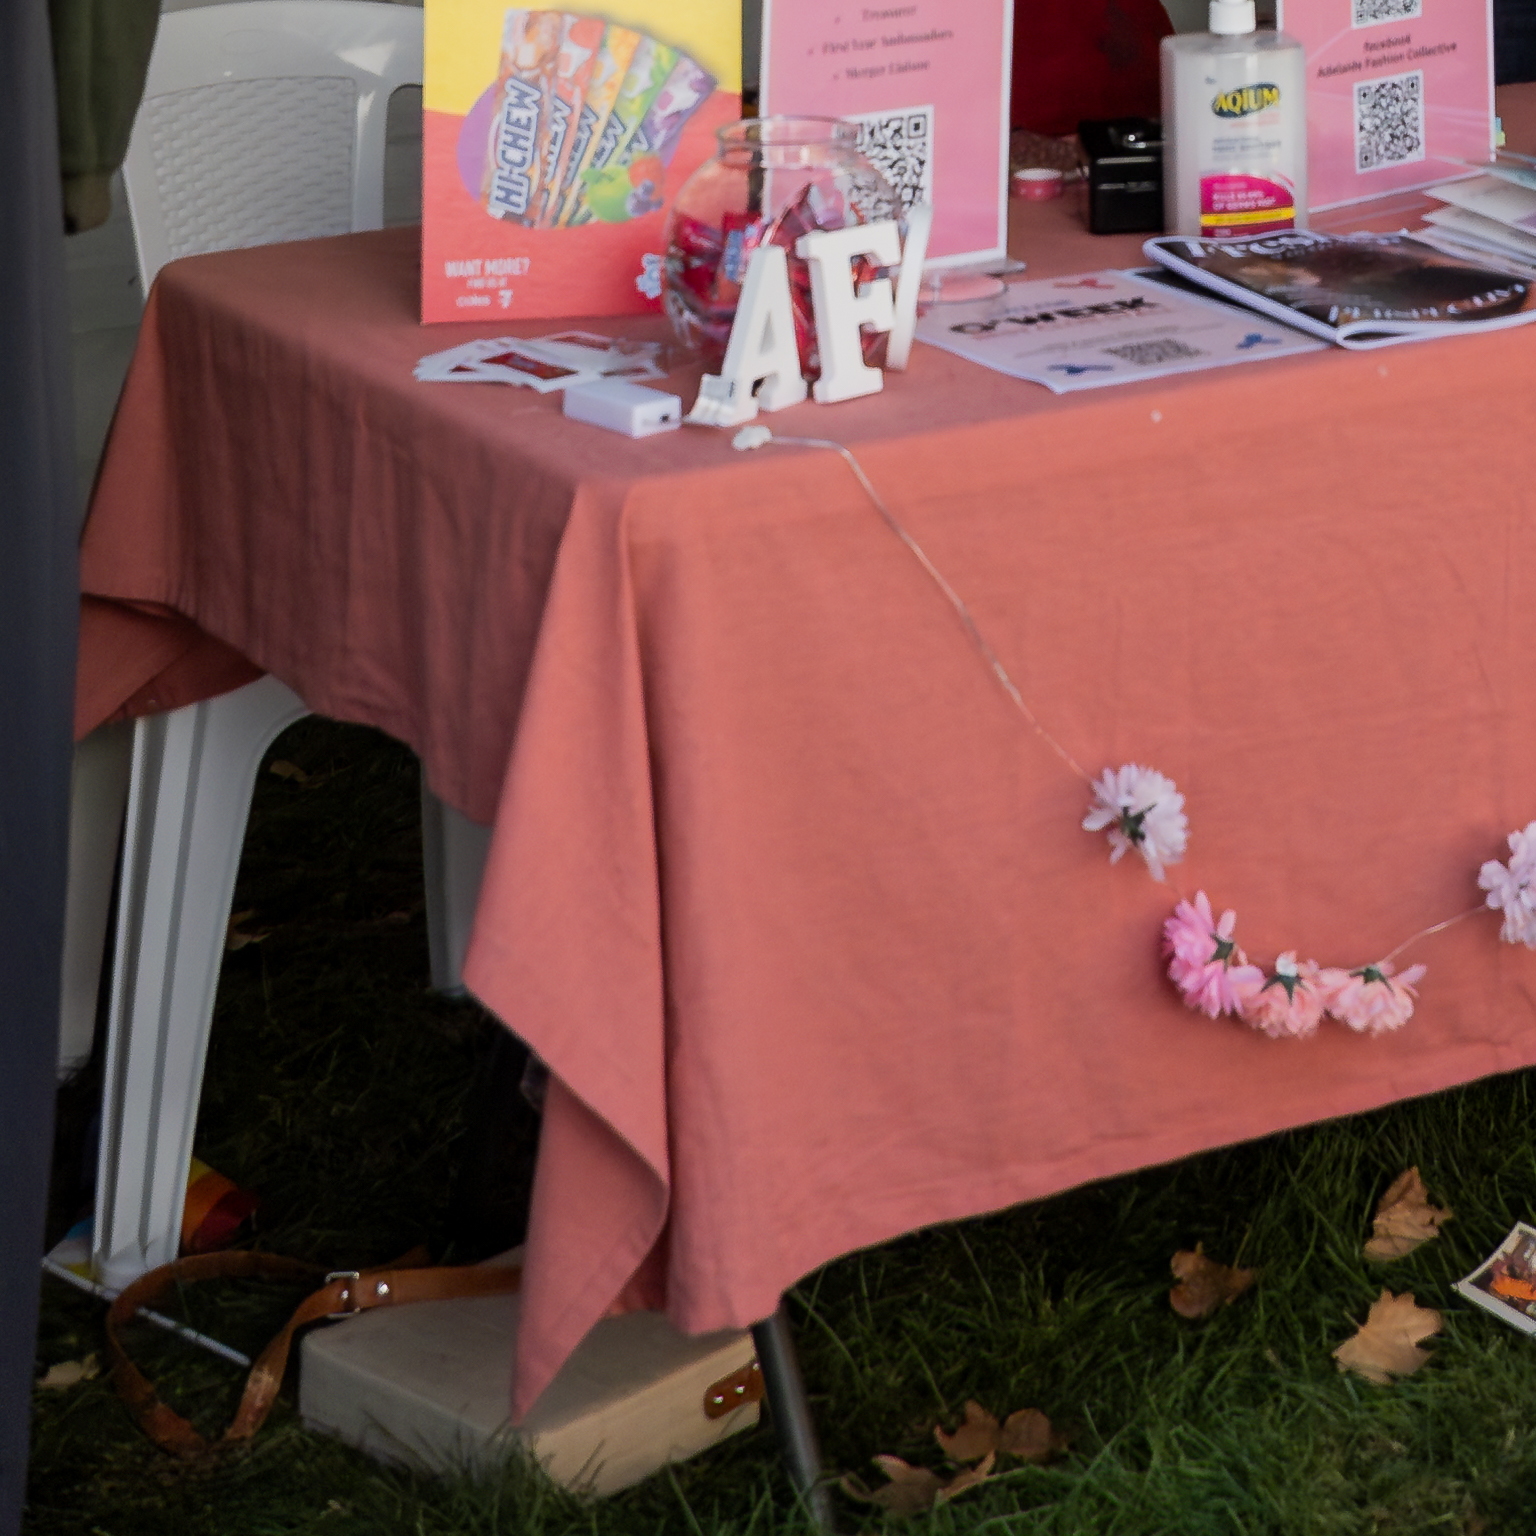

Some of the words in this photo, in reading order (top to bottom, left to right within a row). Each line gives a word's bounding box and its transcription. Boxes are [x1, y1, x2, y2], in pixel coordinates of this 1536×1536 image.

[1365, 51, 1404, 69] Fashion
[1406, 42, 1457, 61] Collective
[1213, 87, 1280, 115] AQIUM
[490, 79, 541, 216] HI-CHEW
